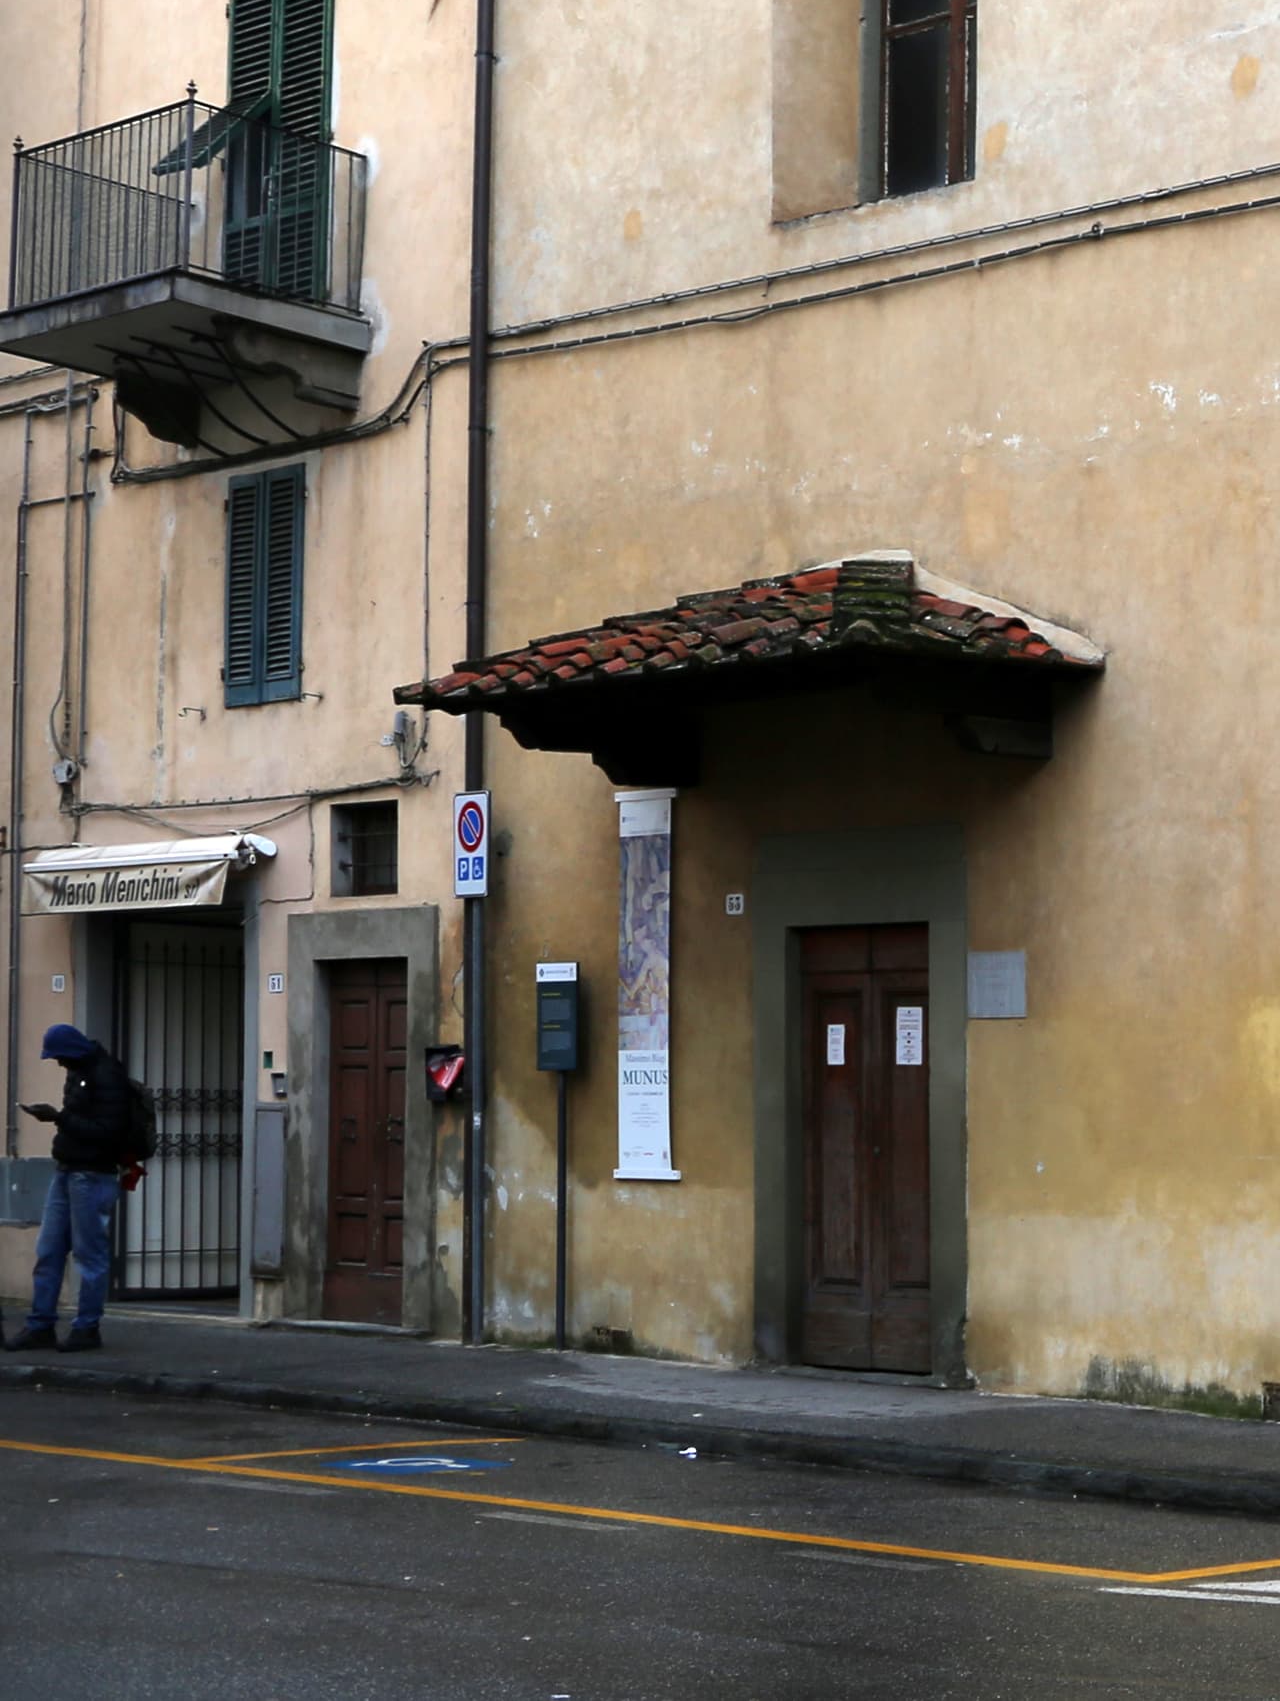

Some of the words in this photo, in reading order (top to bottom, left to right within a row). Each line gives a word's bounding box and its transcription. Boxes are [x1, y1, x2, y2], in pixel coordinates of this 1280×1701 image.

[460, 861, 467, 878] P
[49, 873, 96, 906] Mario
[99, 867, 182, 903] Menichini
[184, 878, 200, 898] srl
[622, 1069, 668, 1085] MUNUS
